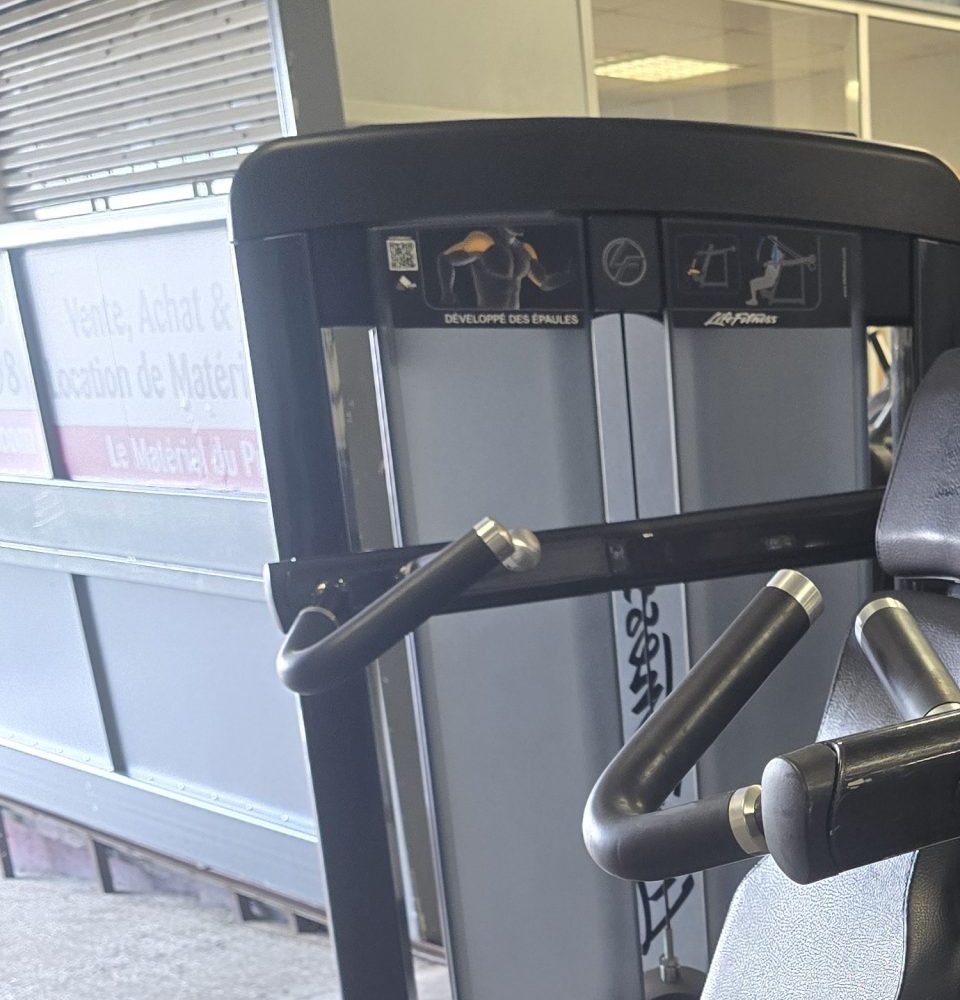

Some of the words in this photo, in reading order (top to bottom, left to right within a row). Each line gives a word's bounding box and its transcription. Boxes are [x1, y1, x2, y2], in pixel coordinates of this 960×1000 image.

[63, 295, 133, 343] Vente,
[138, 282, 206, 334] Achat
[211, 281, 233, 332] &
[444, 312, 506, 324] DÉVELOPPÉ
[508, 314, 530, 324] DES
[531, 313, 579, 325] ÉPAULES
[137, 350, 166, 400] de
[105, 434, 130, 469] Le
[131, 436, 209, 478] Matériel
[211, 437, 239, 477] du
